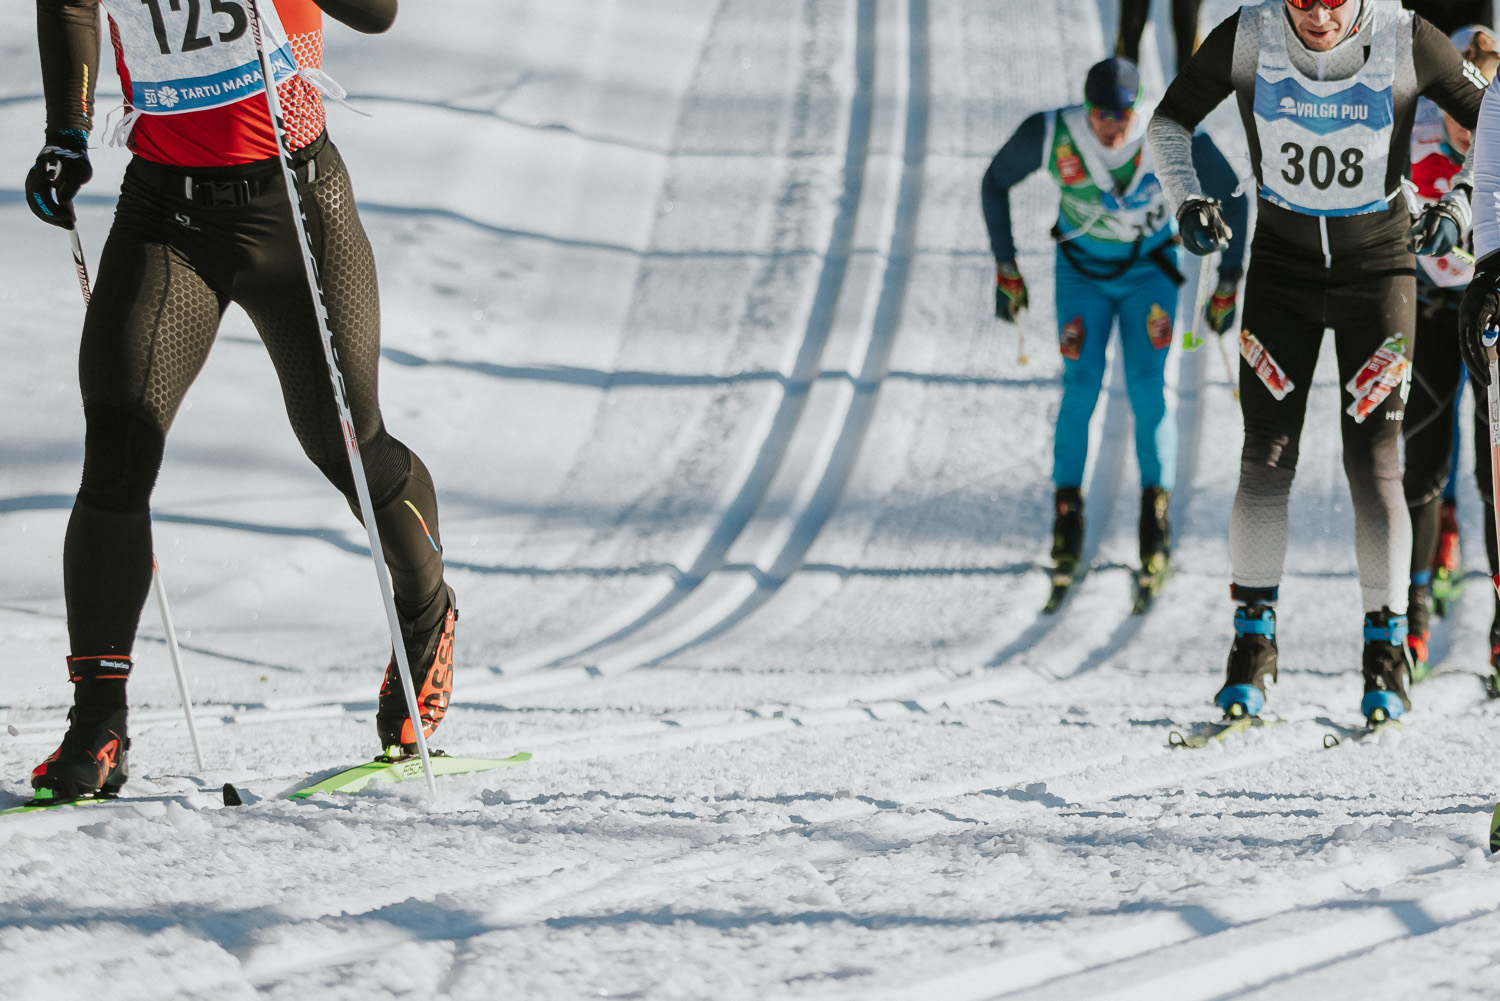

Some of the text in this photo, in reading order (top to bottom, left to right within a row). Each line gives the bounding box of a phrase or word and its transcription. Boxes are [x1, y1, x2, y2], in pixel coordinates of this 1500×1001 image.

[145, 58, 284, 104] 50 TARTU MARAON
[1297, 102, 1368, 120] VALGA PUU
[1280, 141, 1364, 189] 308
